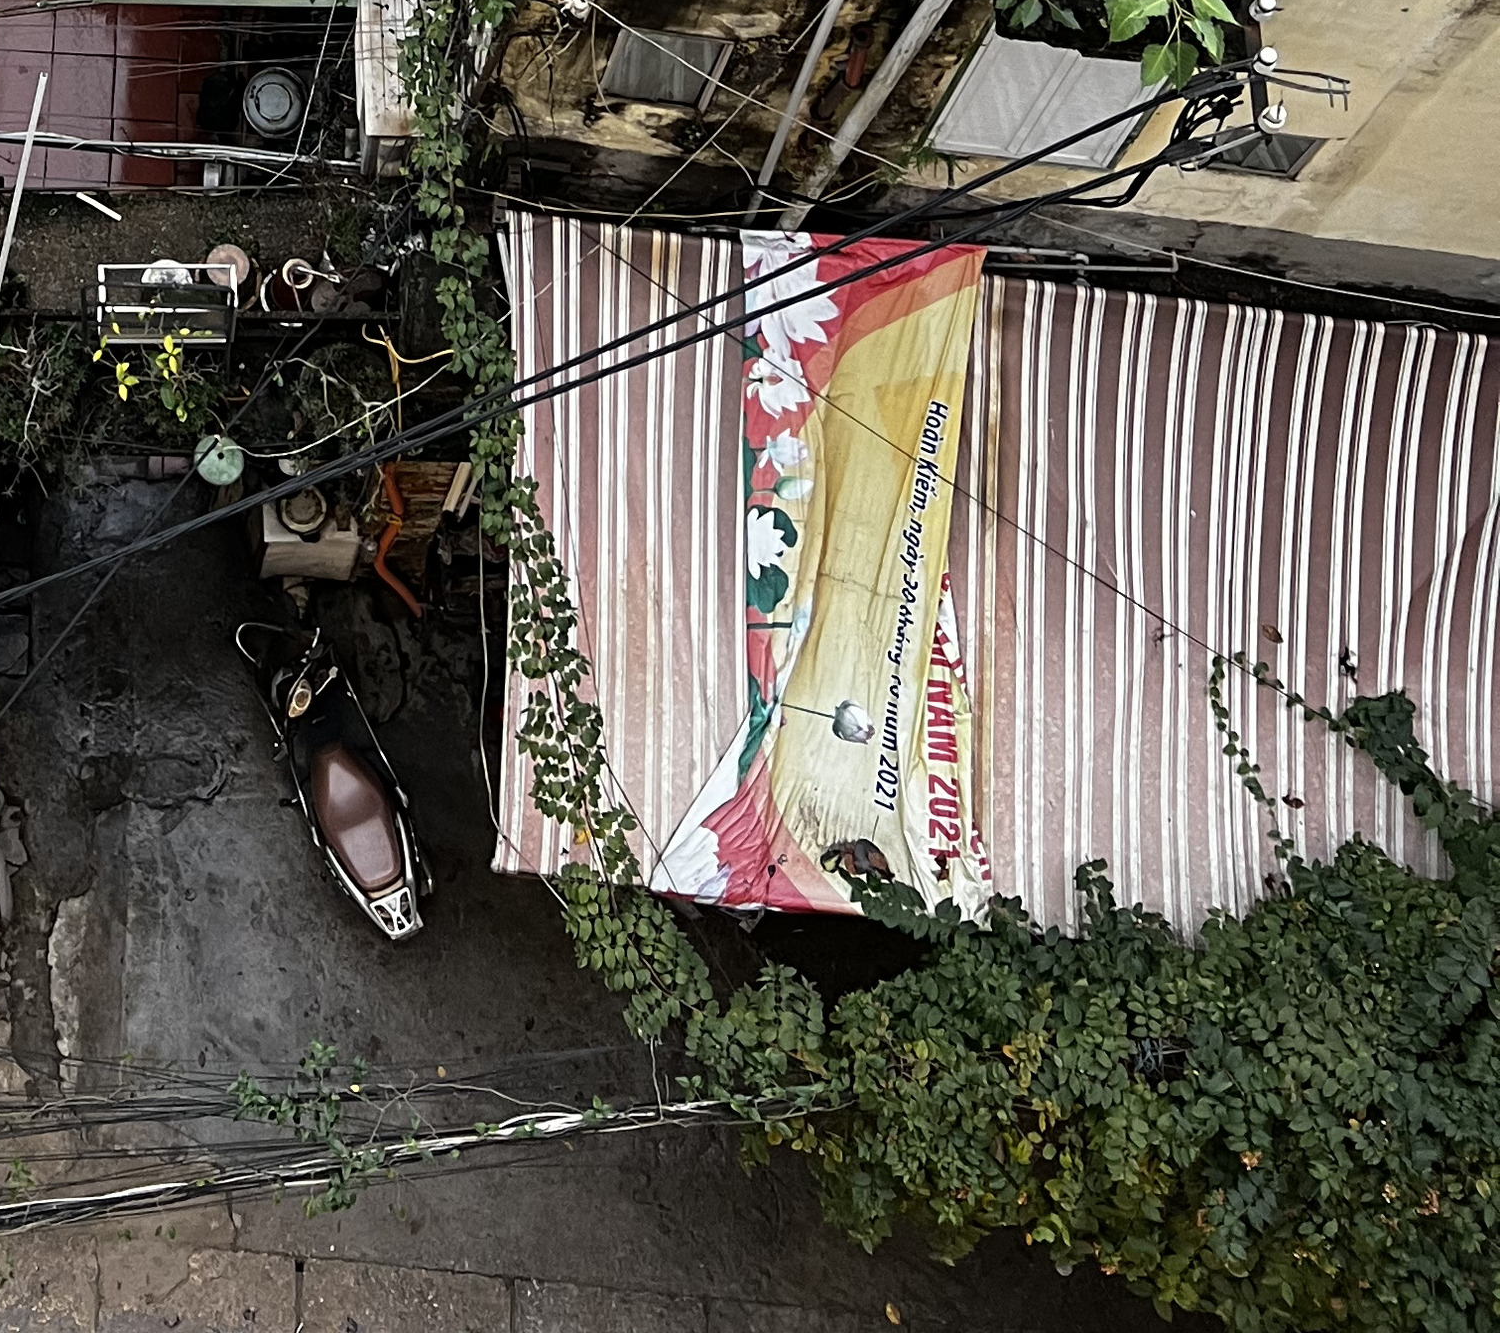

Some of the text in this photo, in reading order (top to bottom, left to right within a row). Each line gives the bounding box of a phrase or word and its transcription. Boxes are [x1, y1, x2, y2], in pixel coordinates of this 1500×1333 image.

[920, 400, 948, 454] Hoàn
[908, 457, 938, 514] Kiếm,
[900, 518, 924, 573] ngày
[873, 754, 900, 812] 2021
[928, 773, 961, 859] 2021
